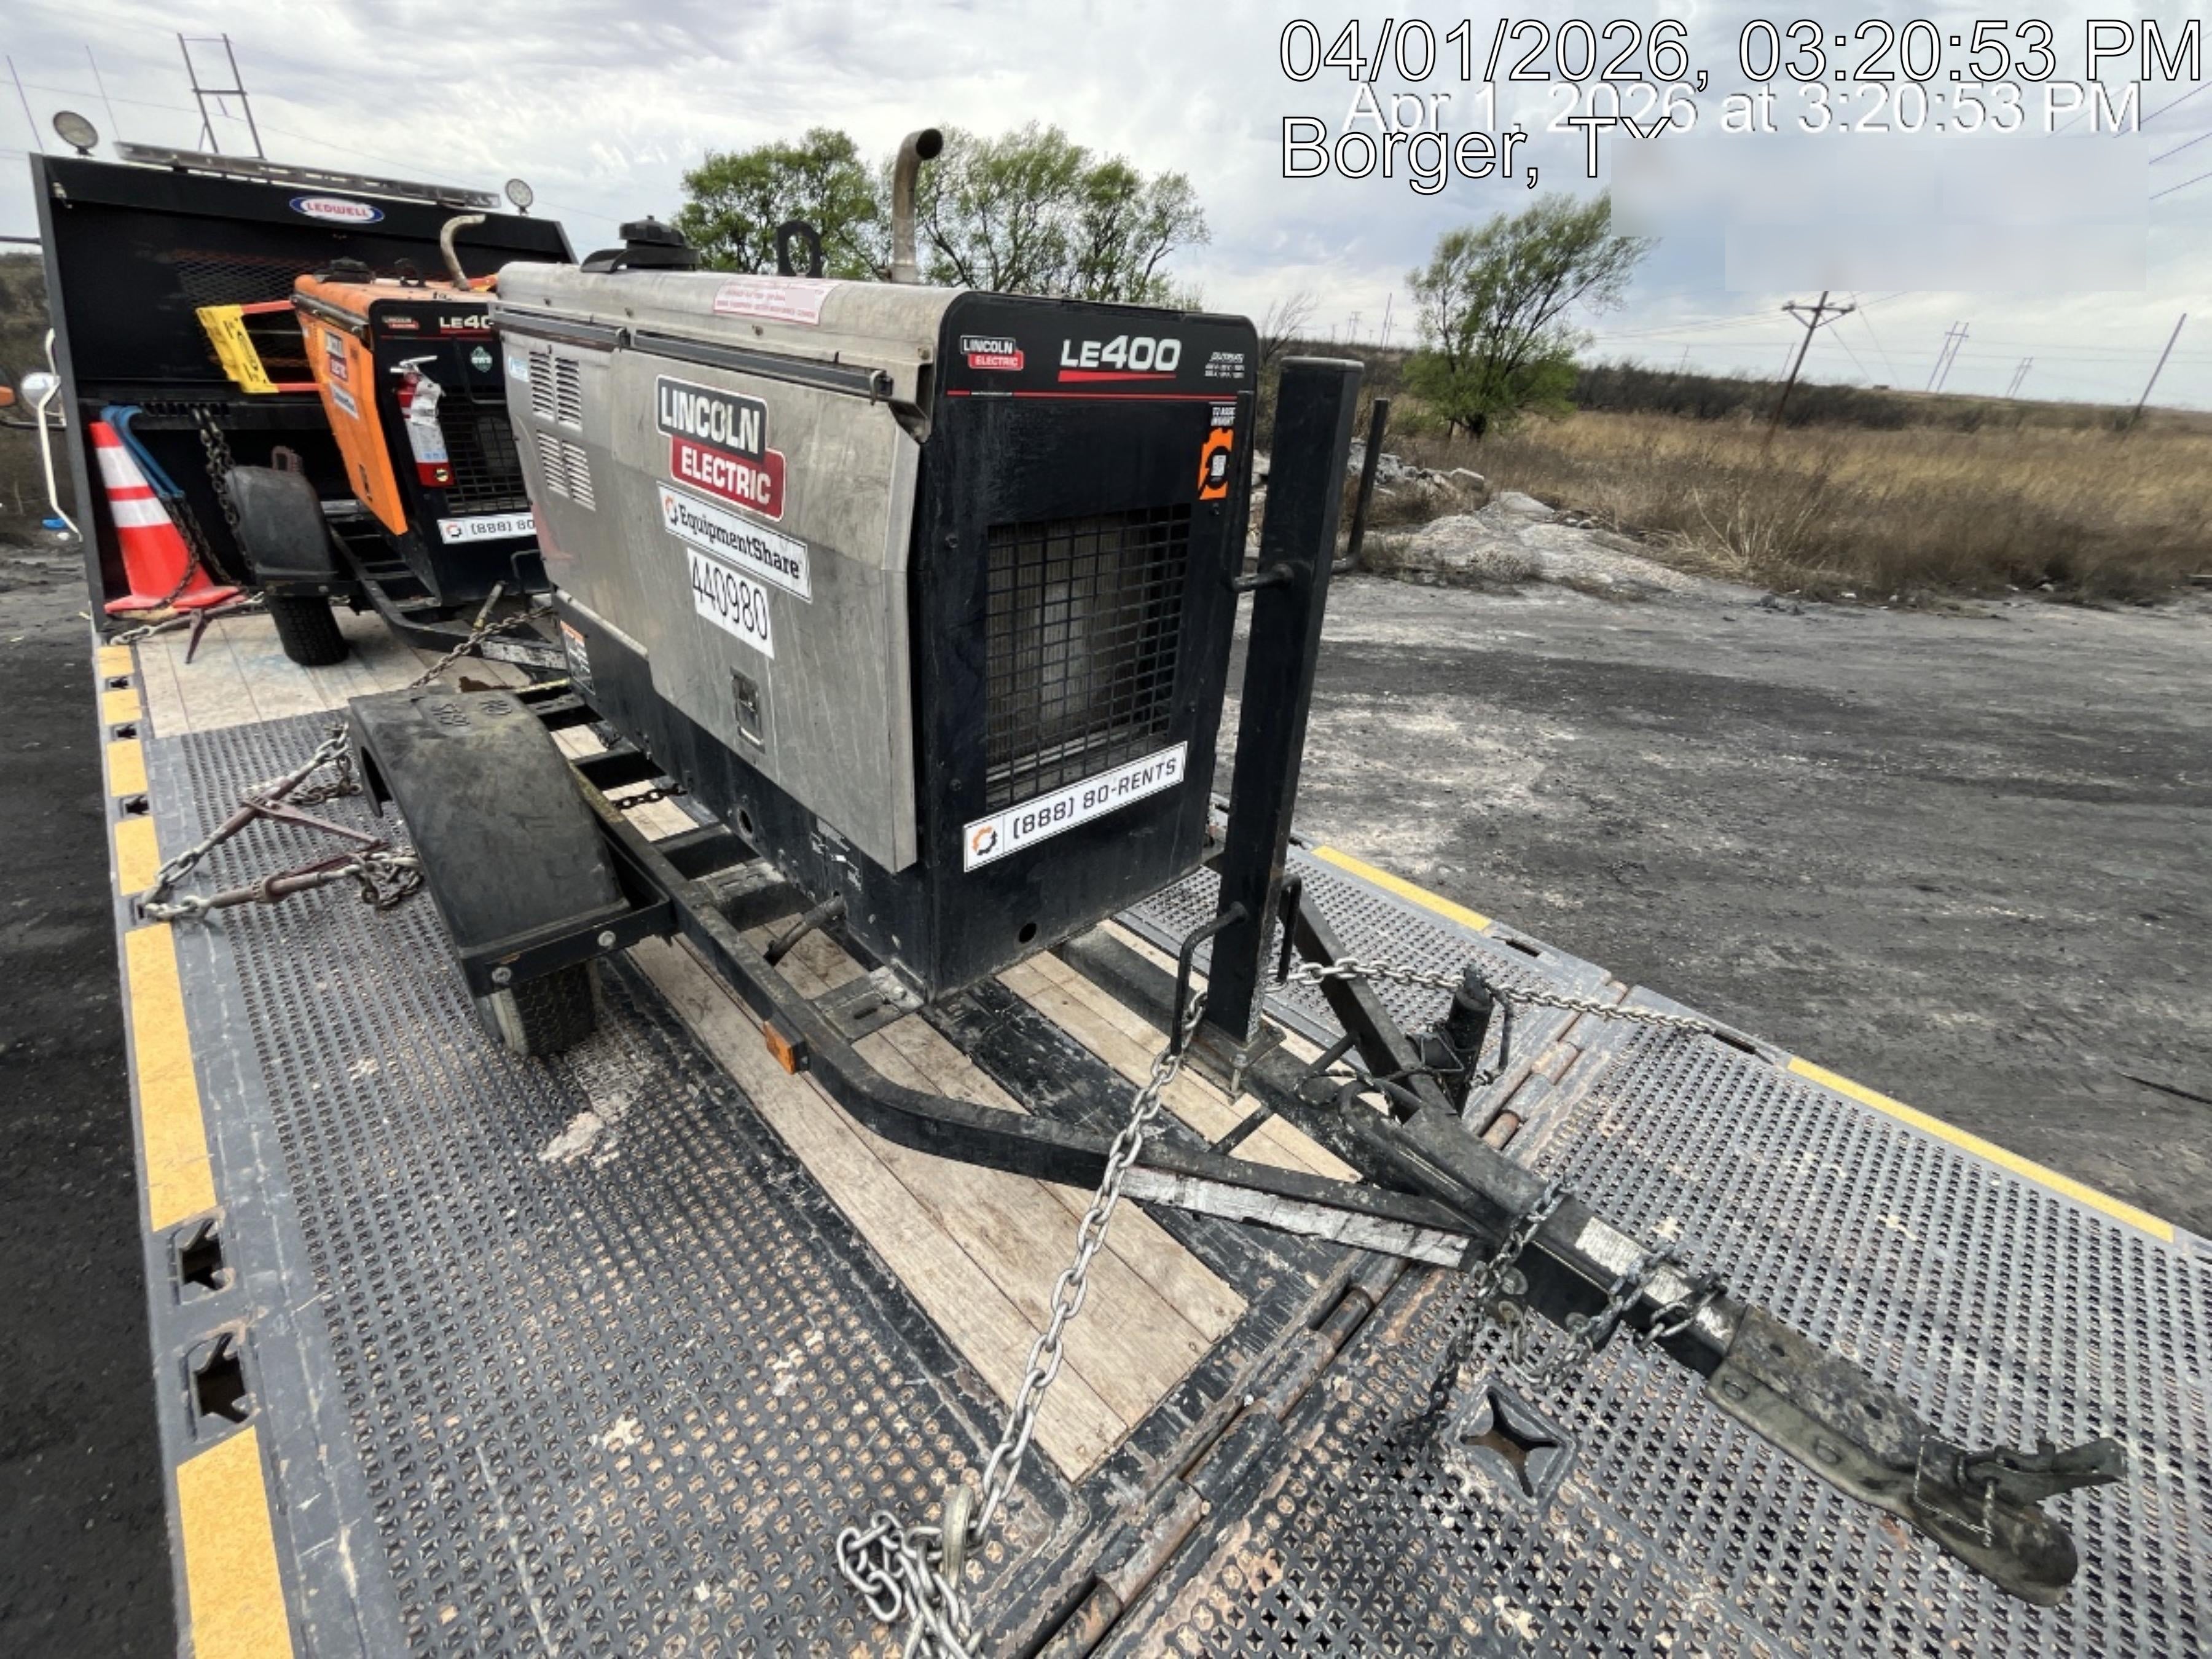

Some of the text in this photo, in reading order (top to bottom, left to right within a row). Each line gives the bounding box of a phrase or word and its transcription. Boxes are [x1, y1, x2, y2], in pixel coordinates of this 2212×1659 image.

[307, 202, 369, 216] LEDWELL
[963, 339, 1013, 355] LINCOLN
[975, 355, 1019, 366] ELECTRIC
[1060, 334, 1182, 371] LE400
[660, 385, 761, 455] LINCOLN
[681, 446, 772, 506] ELECTRIC
[678, 504, 801, 579] EquipmentShare
[692, 555, 768, 641] 440980
[1083, 758, 1177, 810] 80-RENTS
